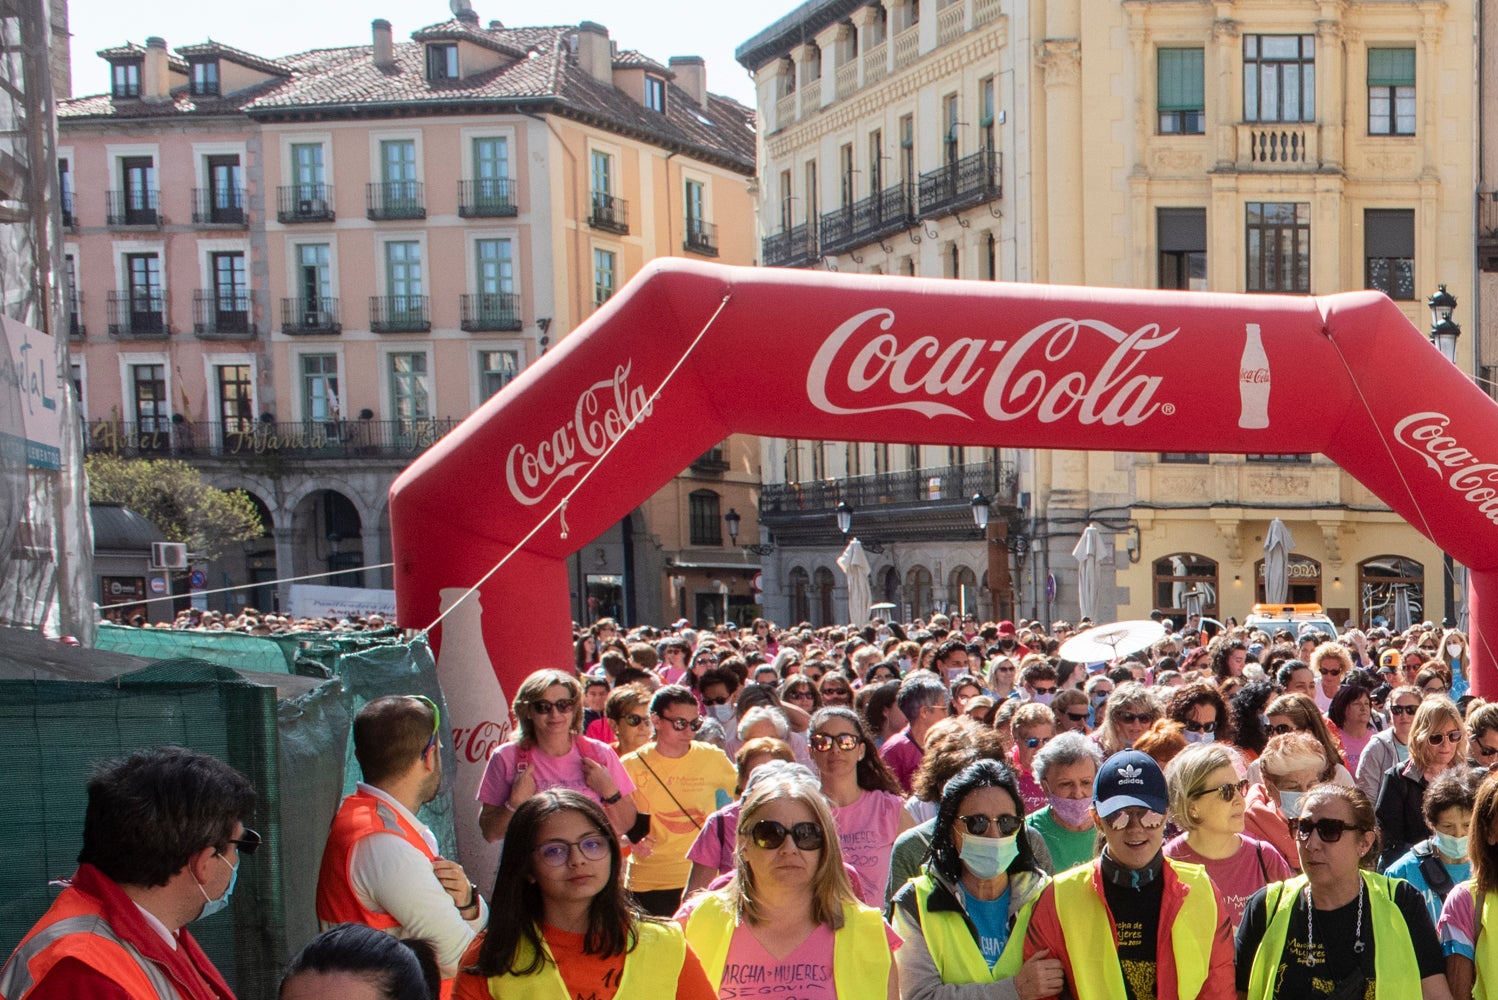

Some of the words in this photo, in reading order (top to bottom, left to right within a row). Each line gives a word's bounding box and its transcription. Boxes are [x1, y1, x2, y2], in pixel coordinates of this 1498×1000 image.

[806, 307, 1181, 427] Coca-Cola
[93, 405, 162, 454] Hotel
[227, 424, 326, 454] Infanta
[506, 357, 654, 505] Coca-Cola
[1118, 778, 1144, 786] adidas
[848, 855, 879, 867] 2019
[1117, 921, 1132, 930] cha
[1133, 921, 1143, 930] de
[1117, 929, 1143, 941] ujeres
[1290, 948, 1327, 960] Mujres
[721, 964, 765, 984] ARCHA
[775, 964, 828, 983] MUJERES
